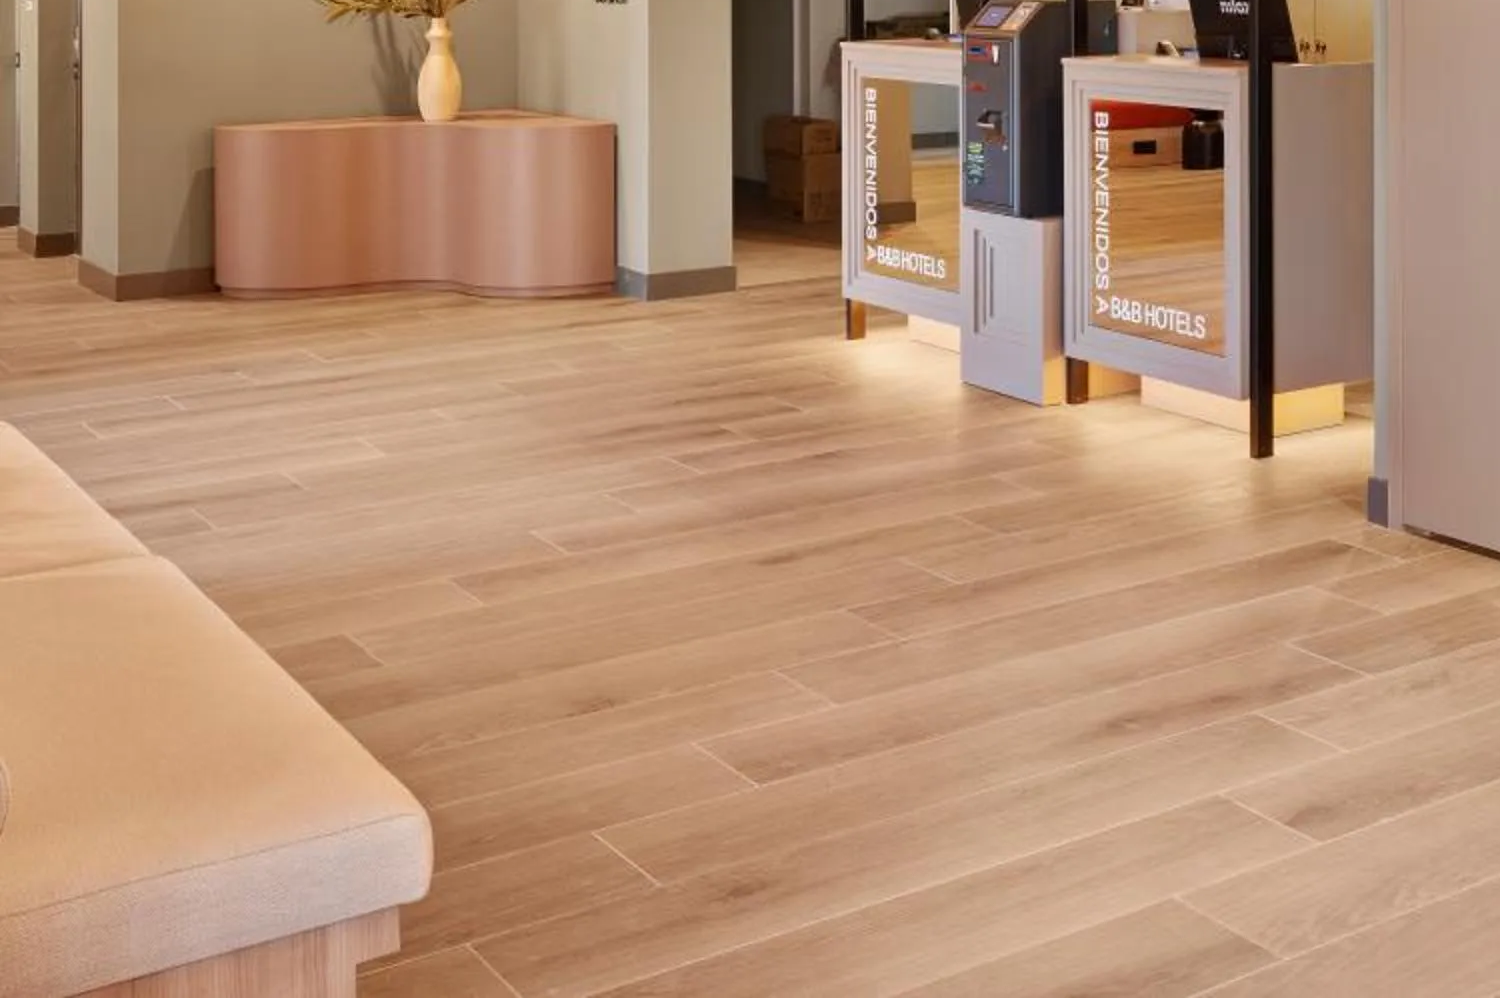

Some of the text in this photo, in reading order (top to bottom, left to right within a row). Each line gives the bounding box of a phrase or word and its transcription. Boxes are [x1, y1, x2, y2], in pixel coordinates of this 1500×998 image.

[865, 87, 877, 241] BIENVENIDOS
[1094, 111, 1110, 315] BIENVENIDOS A
[877, 245, 946, 279] B&B HOTELS
[1110, 296, 1206, 339] B&B HOTELS
